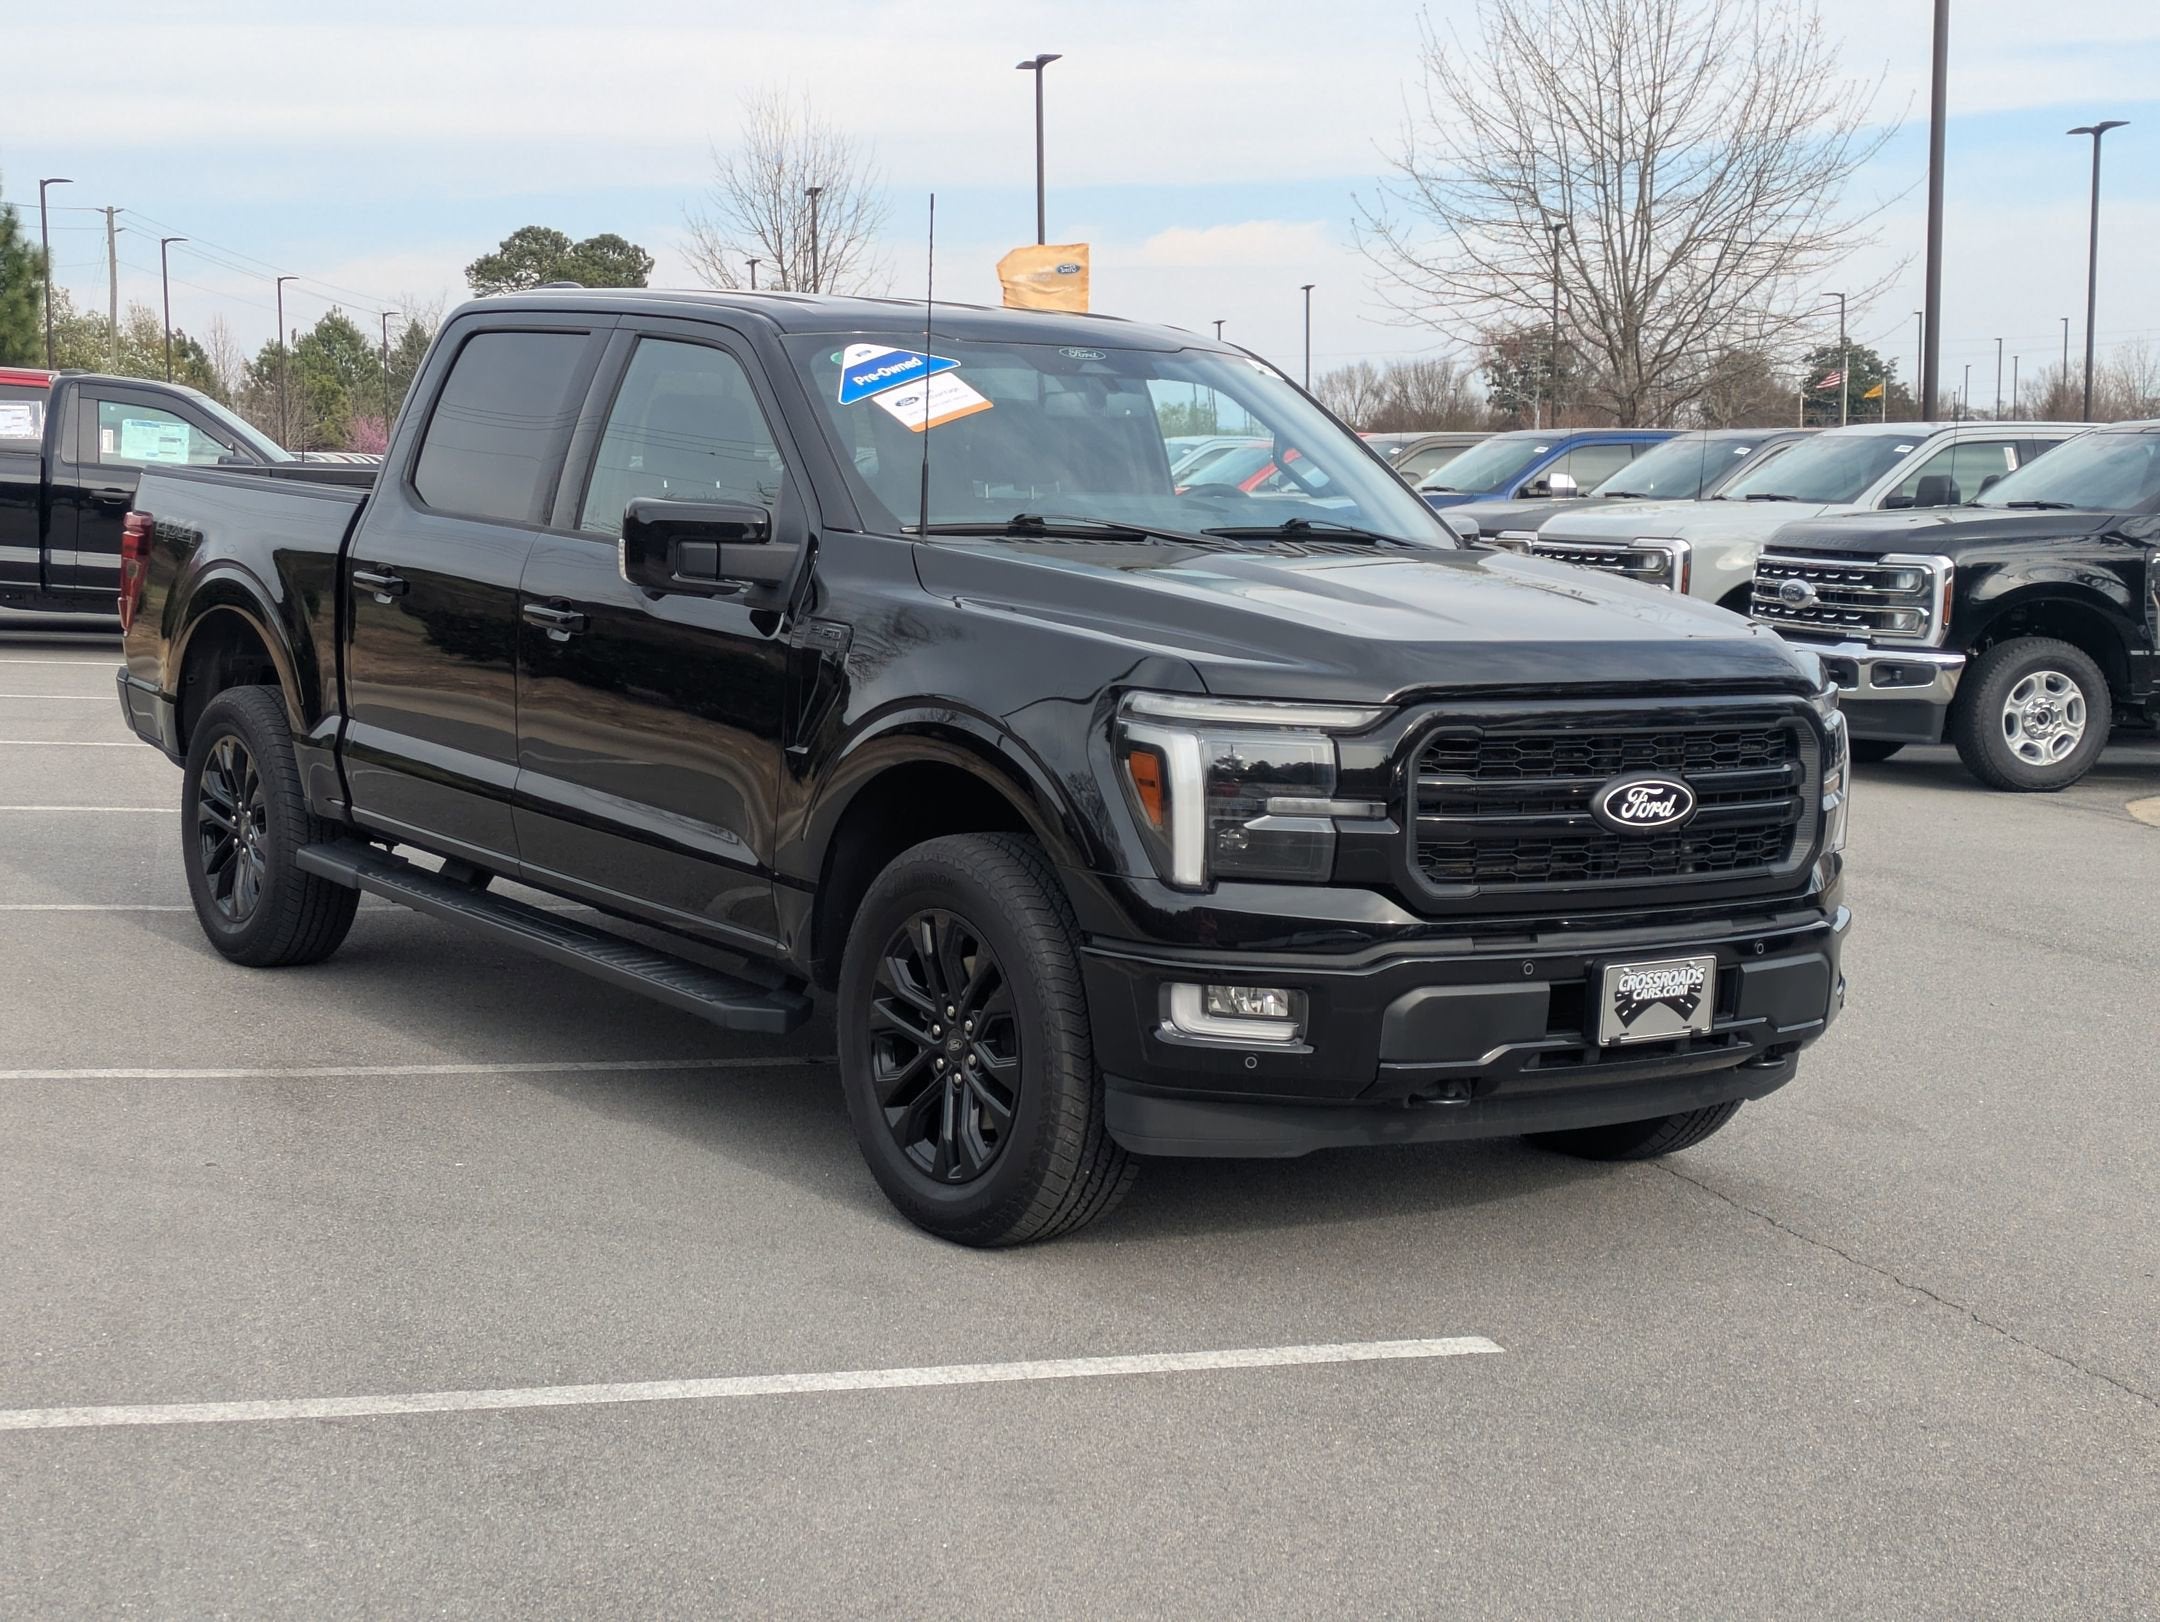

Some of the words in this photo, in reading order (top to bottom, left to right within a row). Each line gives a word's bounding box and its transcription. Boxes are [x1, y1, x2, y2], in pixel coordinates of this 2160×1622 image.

[852, 356, 924, 386] Pre-Owned
[1621, 787, 1677, 818] Ford
[1618, 966, 1706, 992] CROSSROADS
[1633, 985, 1689, 1000] CARS.COM
